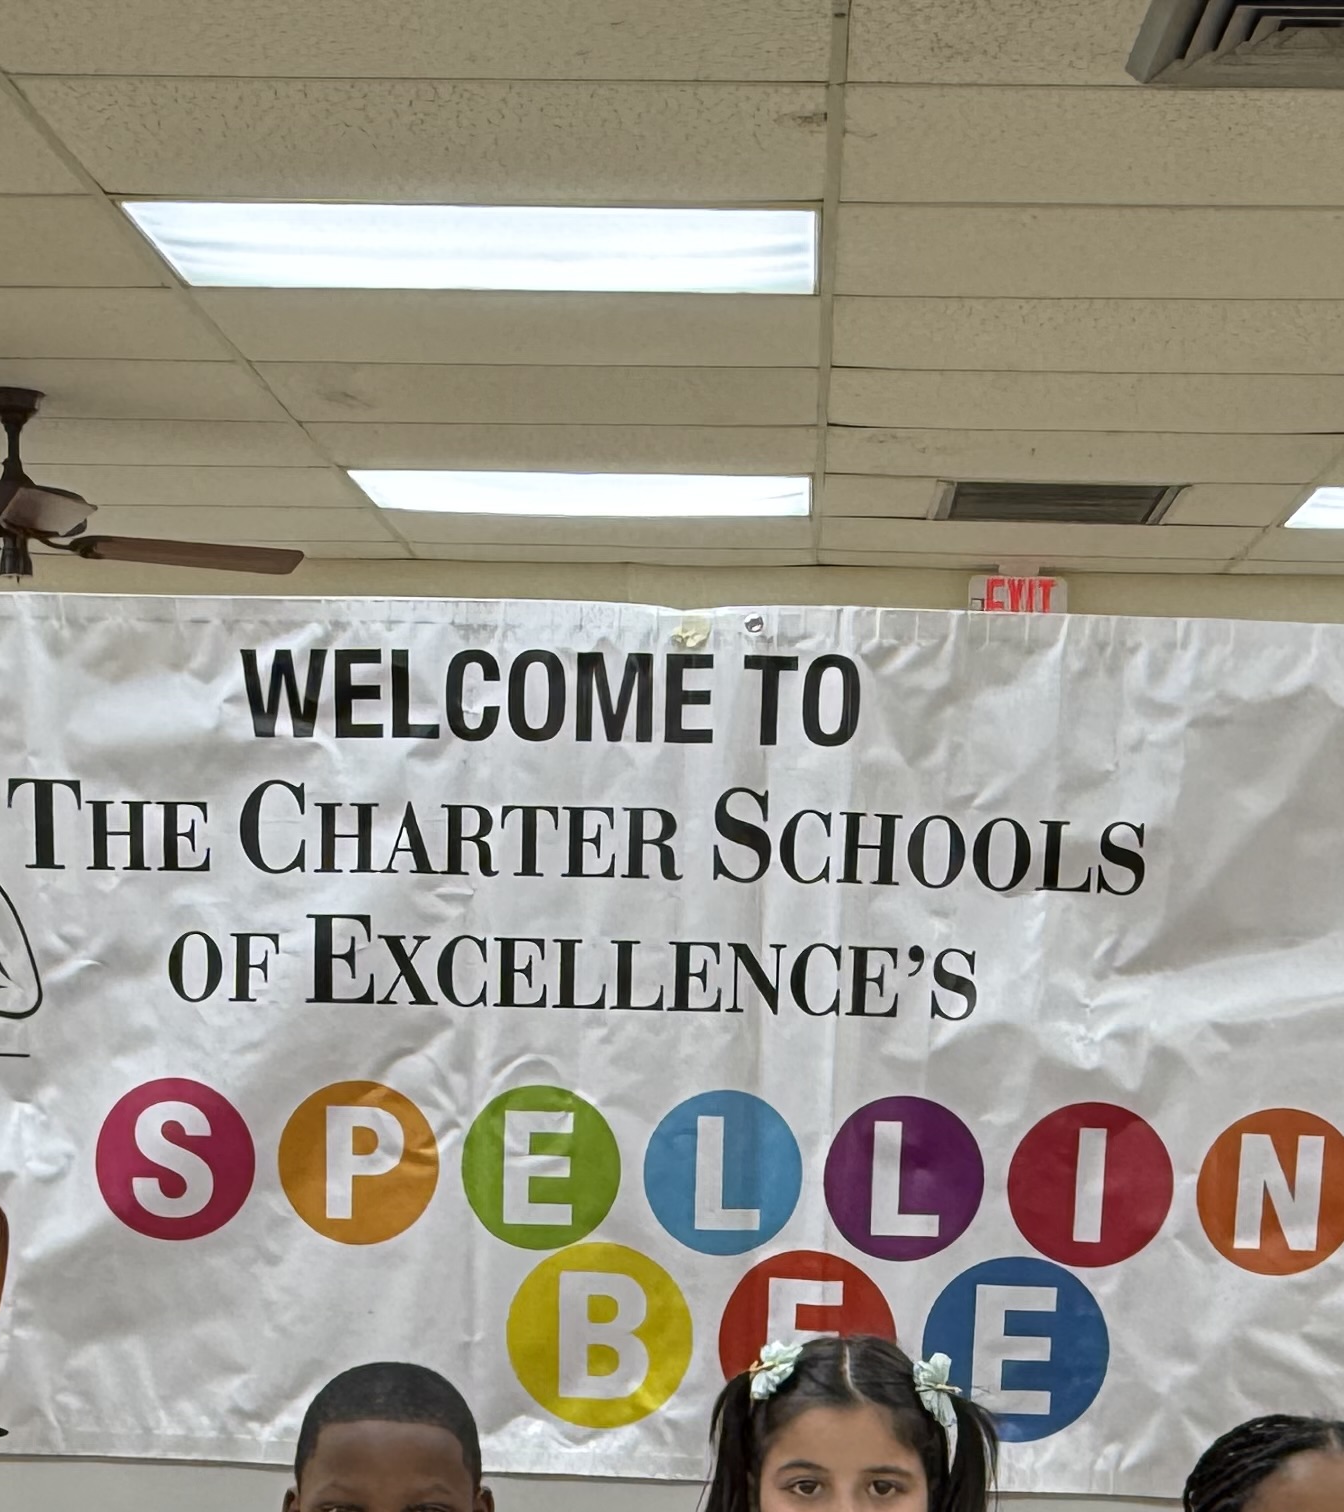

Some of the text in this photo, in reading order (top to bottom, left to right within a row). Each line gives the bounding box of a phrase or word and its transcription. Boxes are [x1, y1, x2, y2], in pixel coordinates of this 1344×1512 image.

[985, 577, 1057, 613] EXIT
[240, 648, 861, 747] WELCOME TO
[7, 777, 1146, 896] THE CHARTER SCHOOLS
[168, 913, 978, 1022] OF EXCELLENCE'S
